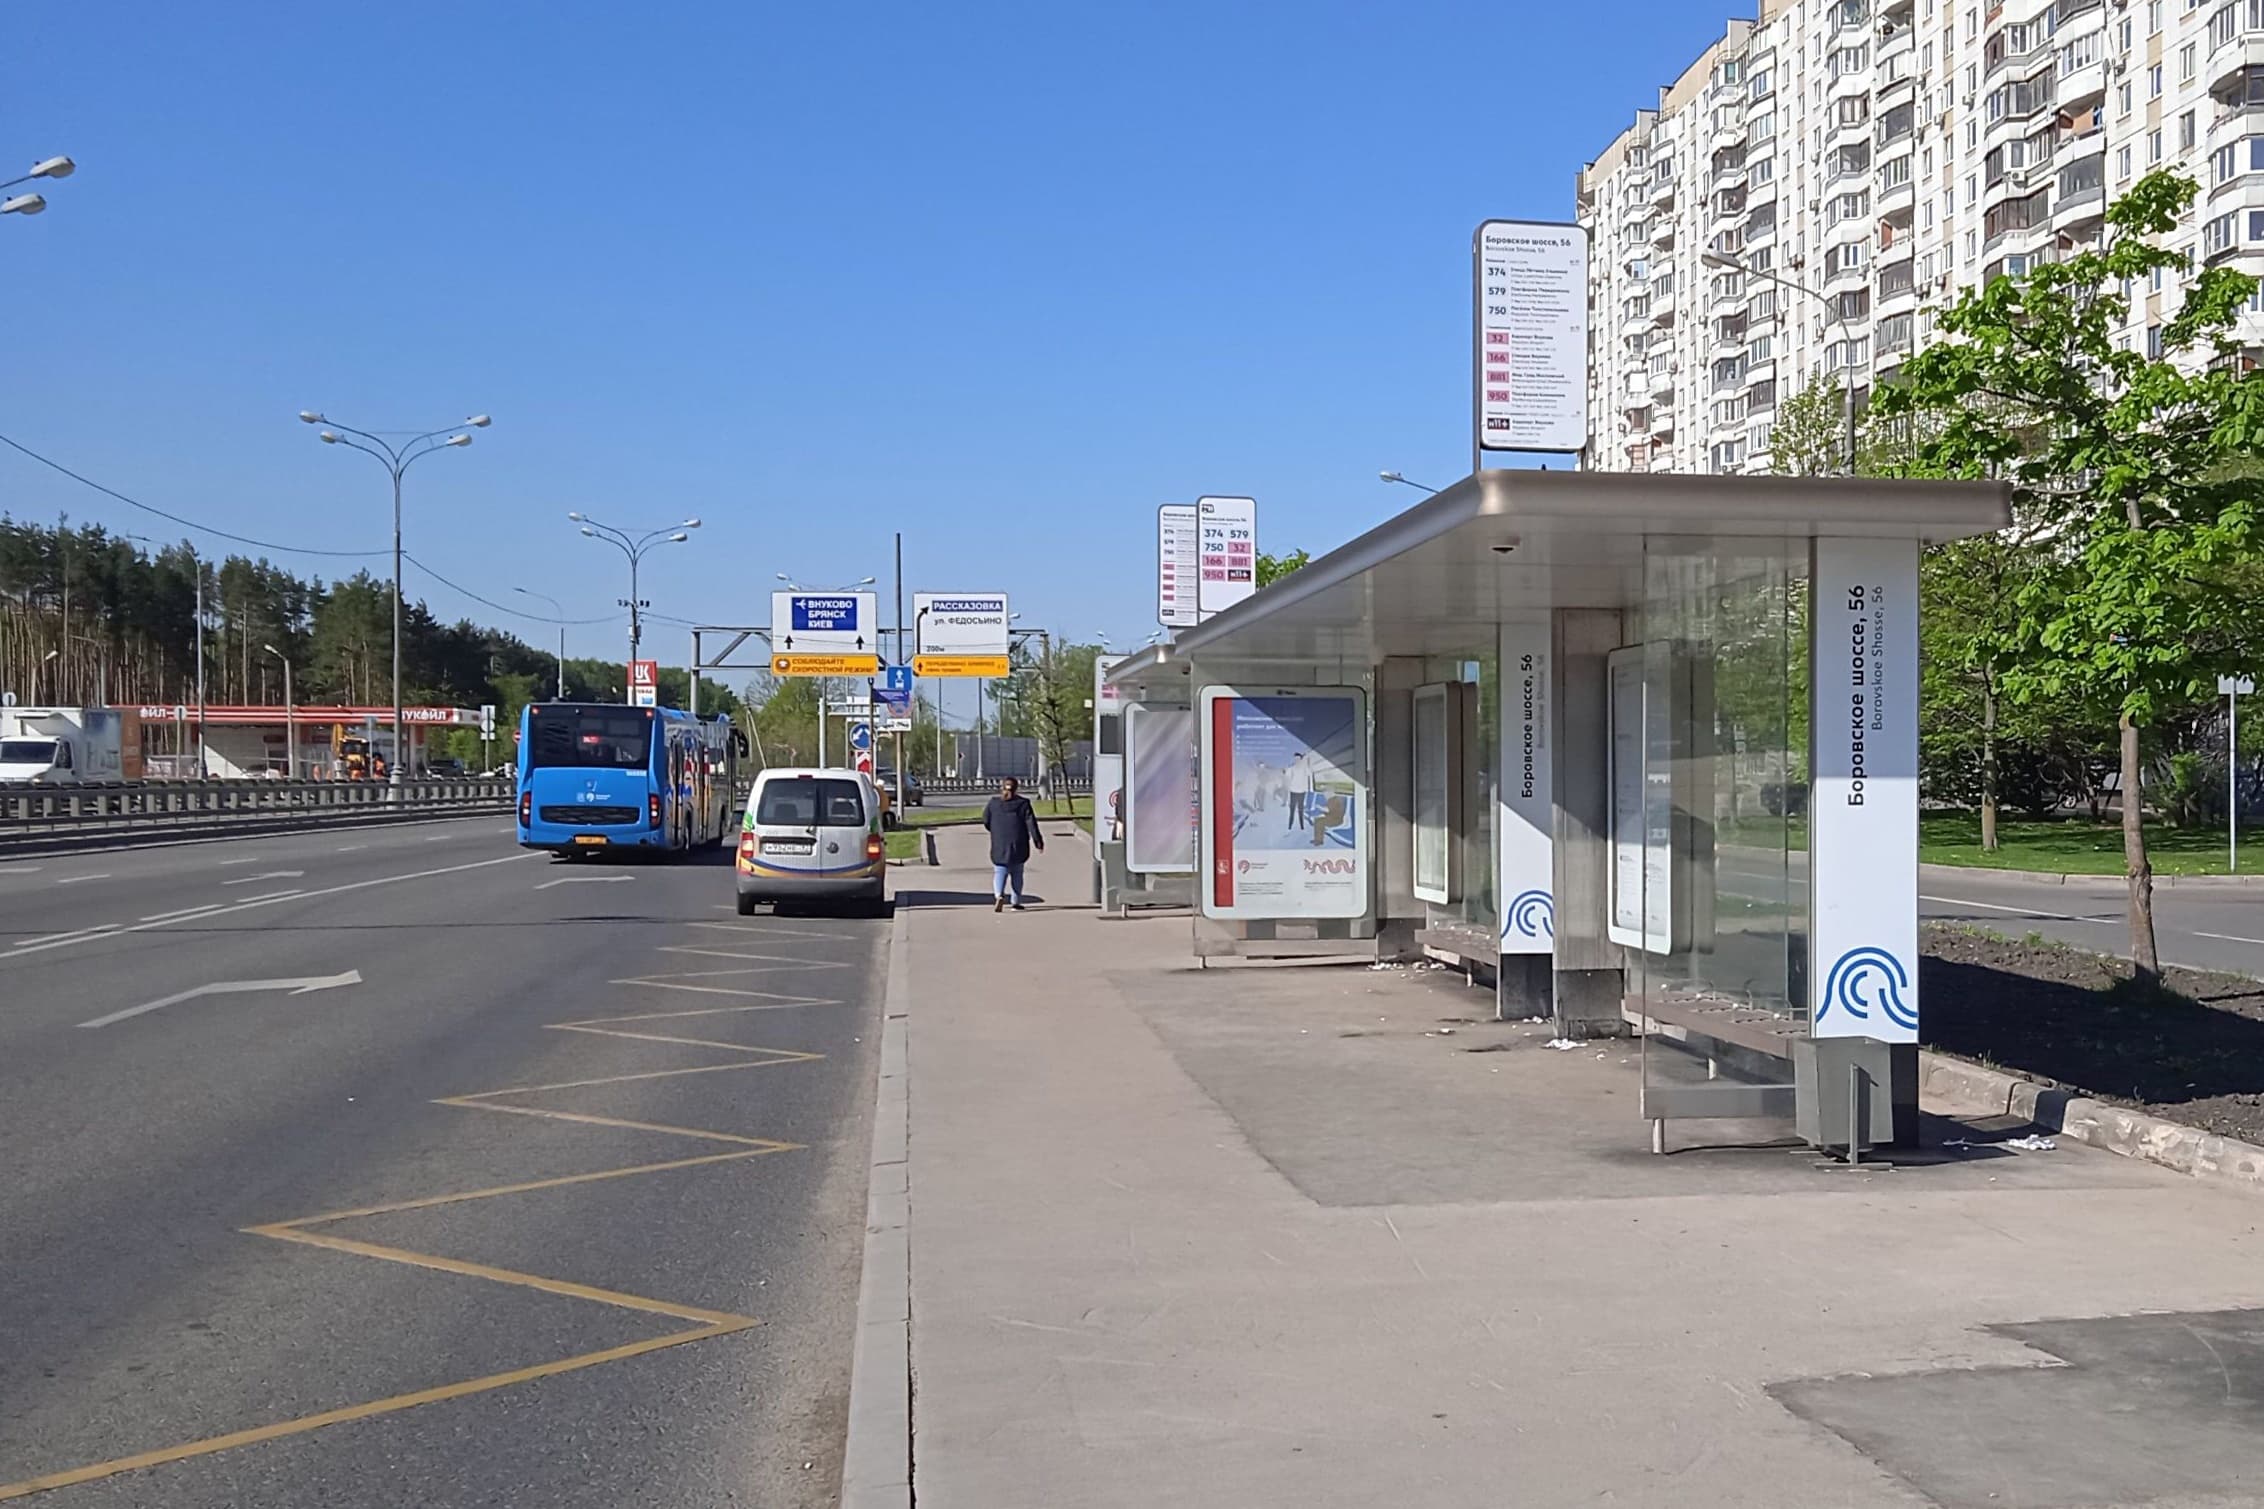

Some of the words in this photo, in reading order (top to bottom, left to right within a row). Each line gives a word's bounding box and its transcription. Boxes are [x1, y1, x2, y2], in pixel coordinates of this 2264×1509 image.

[1486, 235, 1530, 245] Боровское
[1531, 239, 1559, 247] шоссе,
[1560, 238, 1571, 246] 56
[1488, 267, 1506, 276] 374
[1488, 287, 1506, 296] 579
[1488, 306, 1507, 315] 750
[1493, 335, 1504, 343] 32
[1489, 353, 1506, 361] 166
[1489, 391, 1508, 400] 950
[1204, 529, 1224, 538] 374
[1230, 530, 1249, 539] 579
[1204, 543, 1224, 552] 750
[1233, 544, 1246, 553] 32
[1205, 556, 1223, 565] 166
[1204, 570, 1224, 580] 950
[1848, 585, 1865, 611] 56
[1872, 586, 1883, 603] 56
[808, 600, 853, 609] ВНУКОВО
[808, 610, 846, 618] БРЯНСК
[808, 620, 833, 628] КИЕВ
[1872, 607, 1884, 657] Shosse,
[1852, 617, 1867, 686] шоссе,
[1521, 654, 1532, 671] 56
[1524, 675, 1534, 720] шоссе,
[1872, 661, 1883, 731] Borovskoe
[1848, 693, 1867, 806] Боровское
[1522, 724, 1534, 798] Боровское
